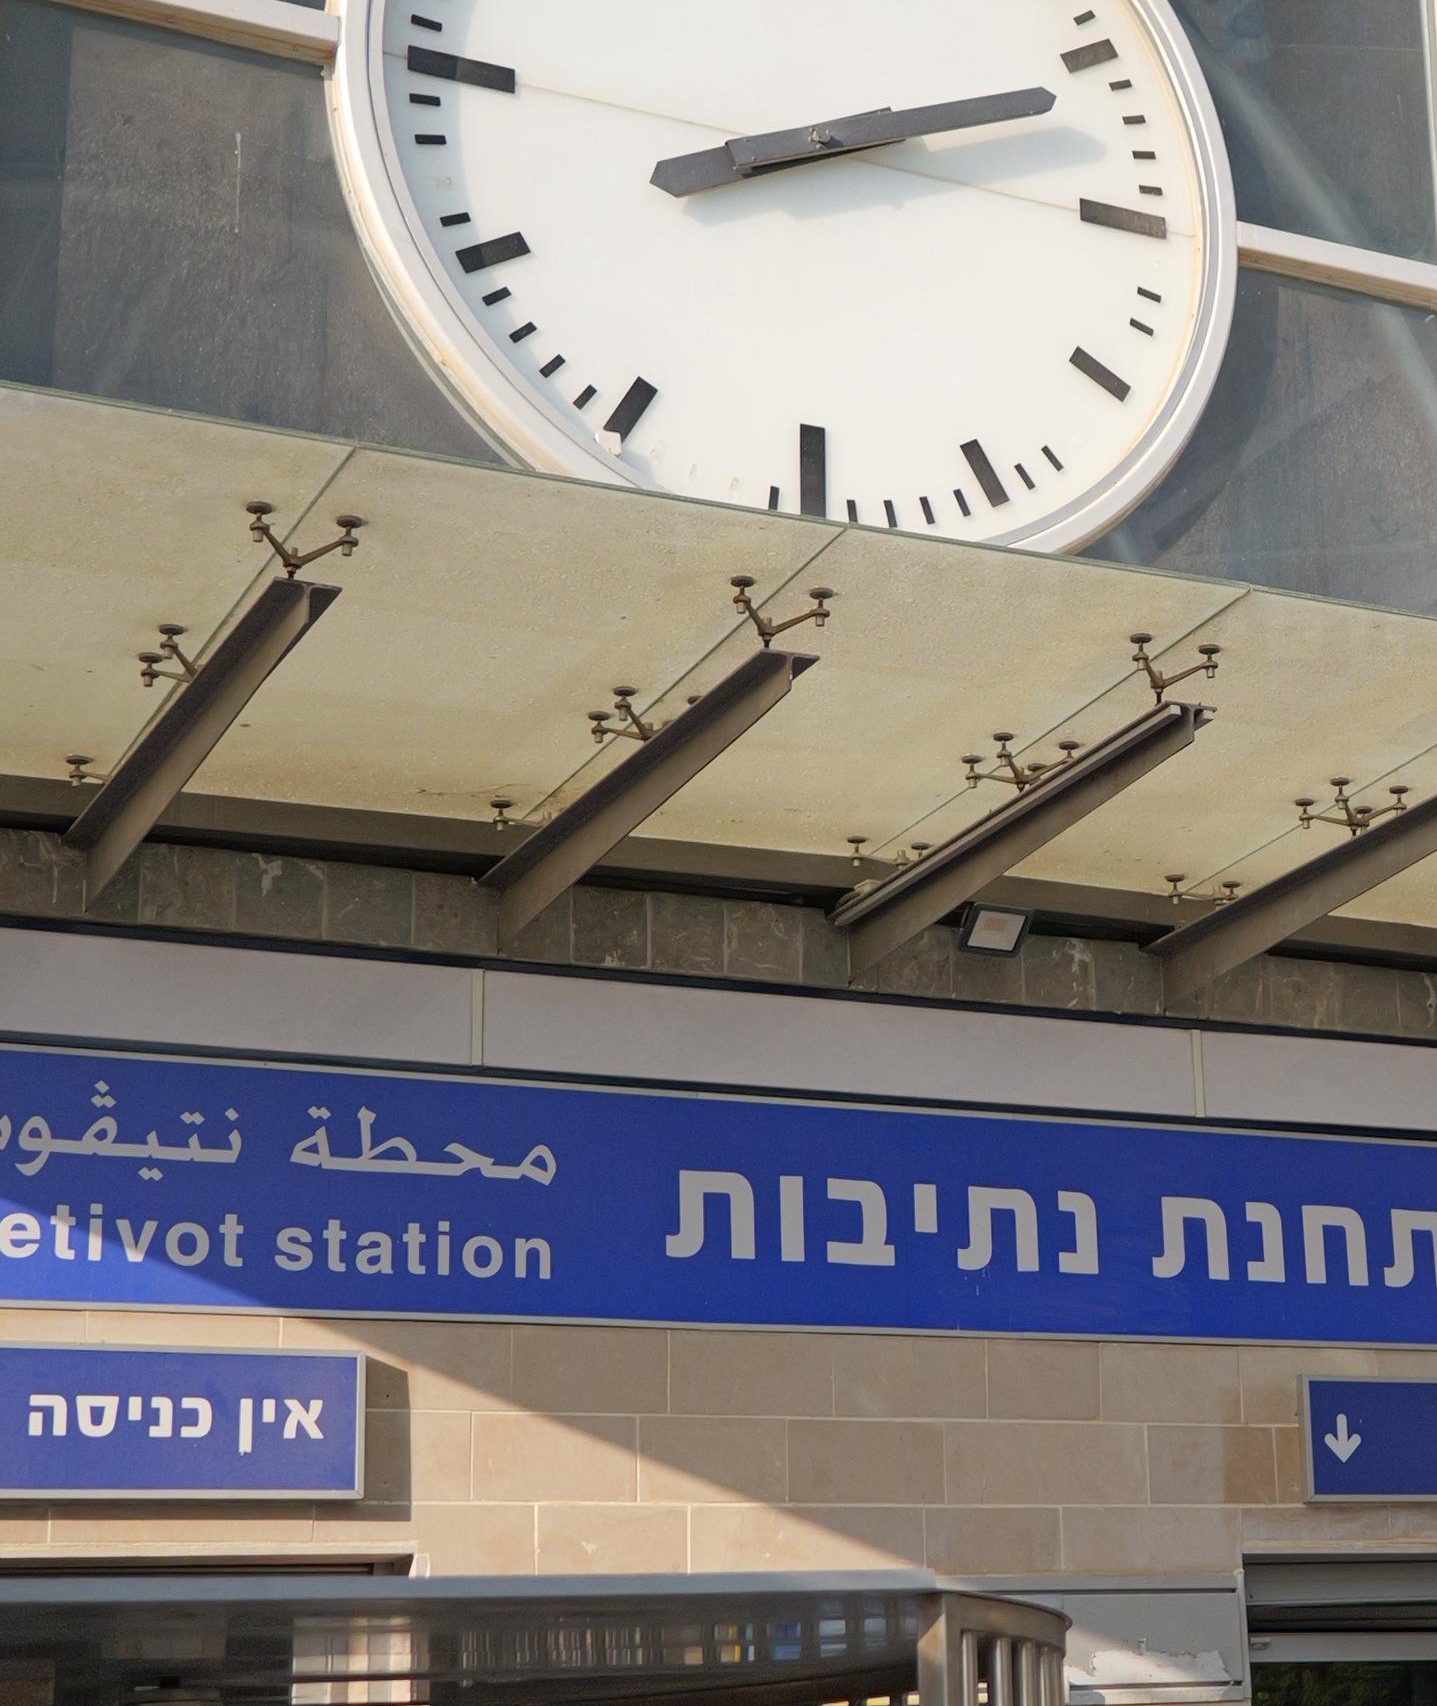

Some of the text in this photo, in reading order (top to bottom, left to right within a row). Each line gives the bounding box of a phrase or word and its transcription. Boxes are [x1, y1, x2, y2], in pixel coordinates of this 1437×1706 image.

[0, 1080, 557, 1186] محطة نتيڤو
[0, 1203, 551, 1280] etivot station
[666, 1169, 1099, 1275] נתיבות
[28, 1394, 325, 1454] אין כניסה
